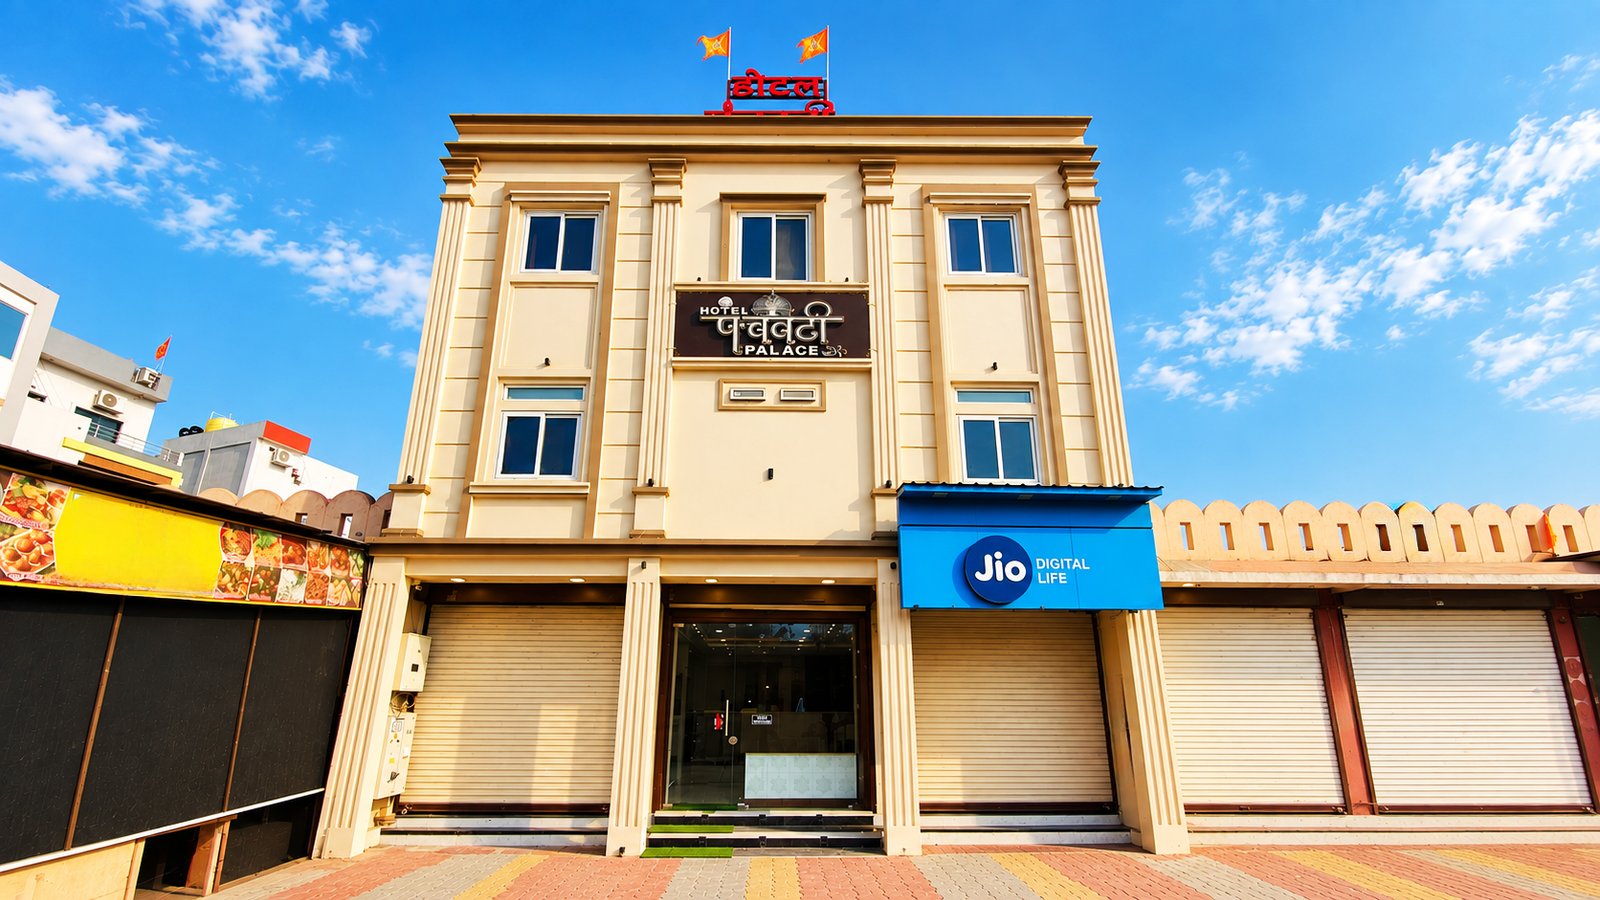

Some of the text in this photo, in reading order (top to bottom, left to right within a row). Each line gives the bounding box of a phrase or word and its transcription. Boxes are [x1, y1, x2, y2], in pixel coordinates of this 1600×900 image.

[731, 68, 823, 97] होटल
[700, 306, 748, 315] HOTEL
[745, 345, 819, 356] PALACE
[974, 551, 1026, 582] Jio
[1036, 558, 1090, 570] DIGITAL
[1038, 572, 1067, 584] LIFE
